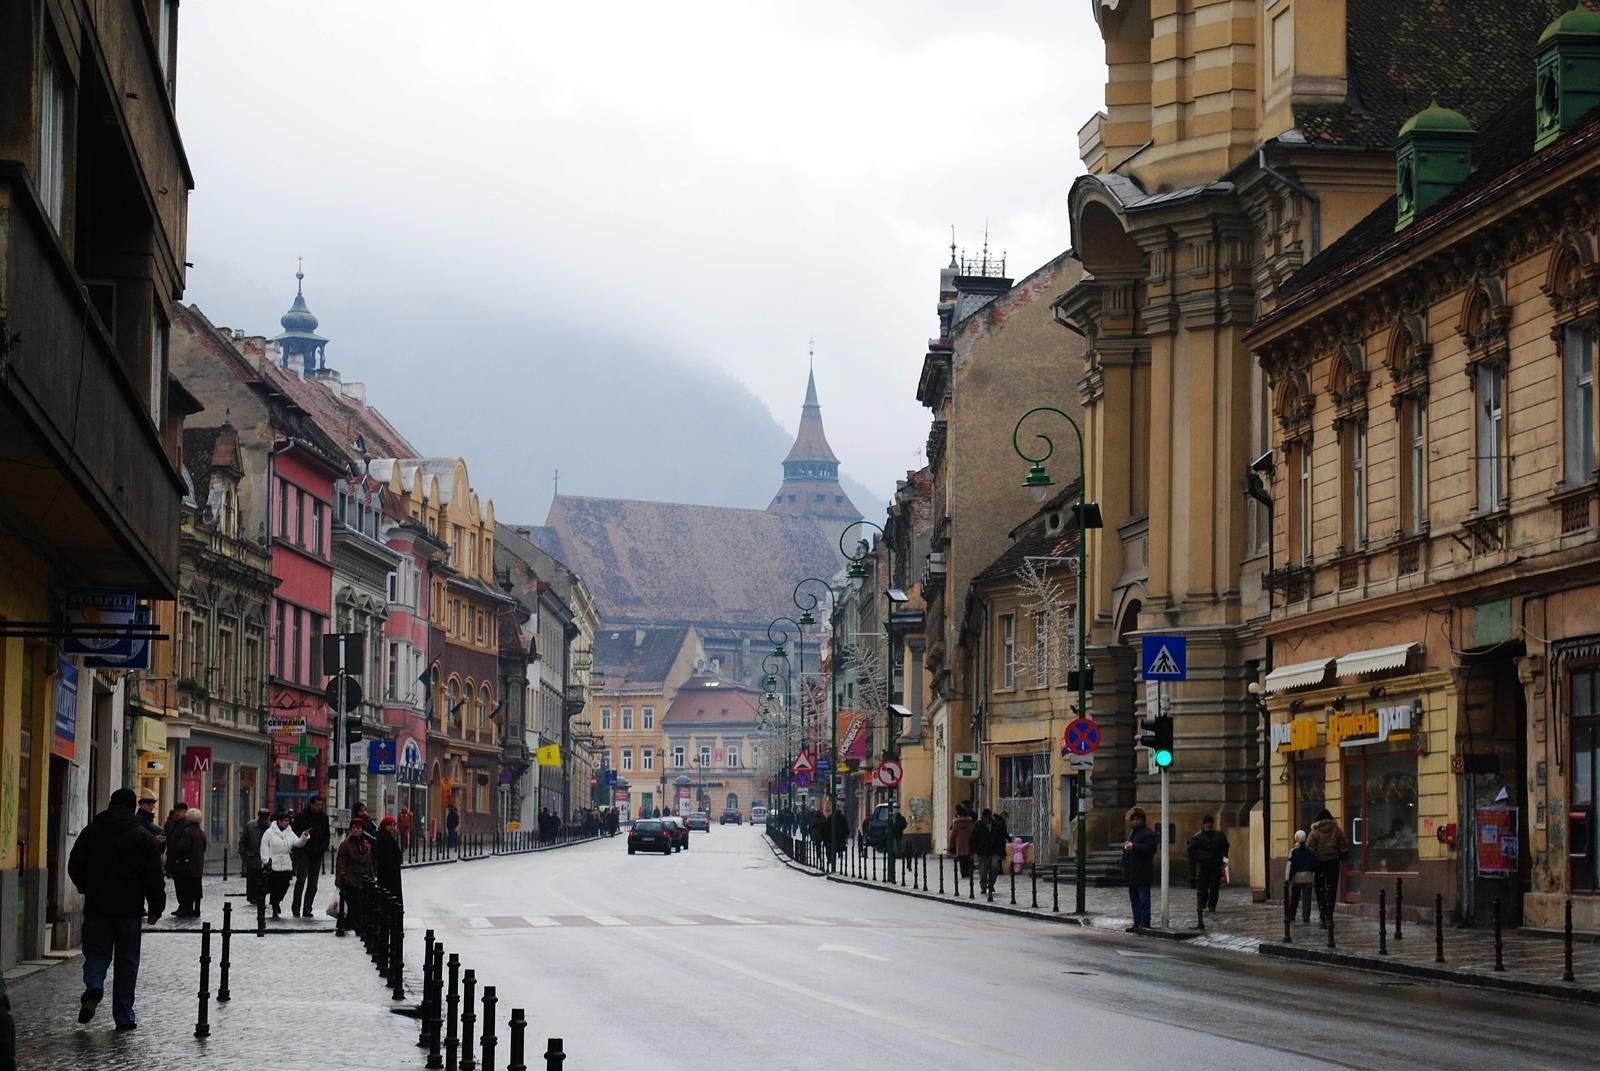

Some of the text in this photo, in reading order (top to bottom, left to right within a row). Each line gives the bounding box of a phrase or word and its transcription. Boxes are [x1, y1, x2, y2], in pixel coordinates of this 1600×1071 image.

[267, 719, 305, 727] GERMANIA
[838, 720, 863, 759] HORNBACH
[194, 755, 209, 771] M
